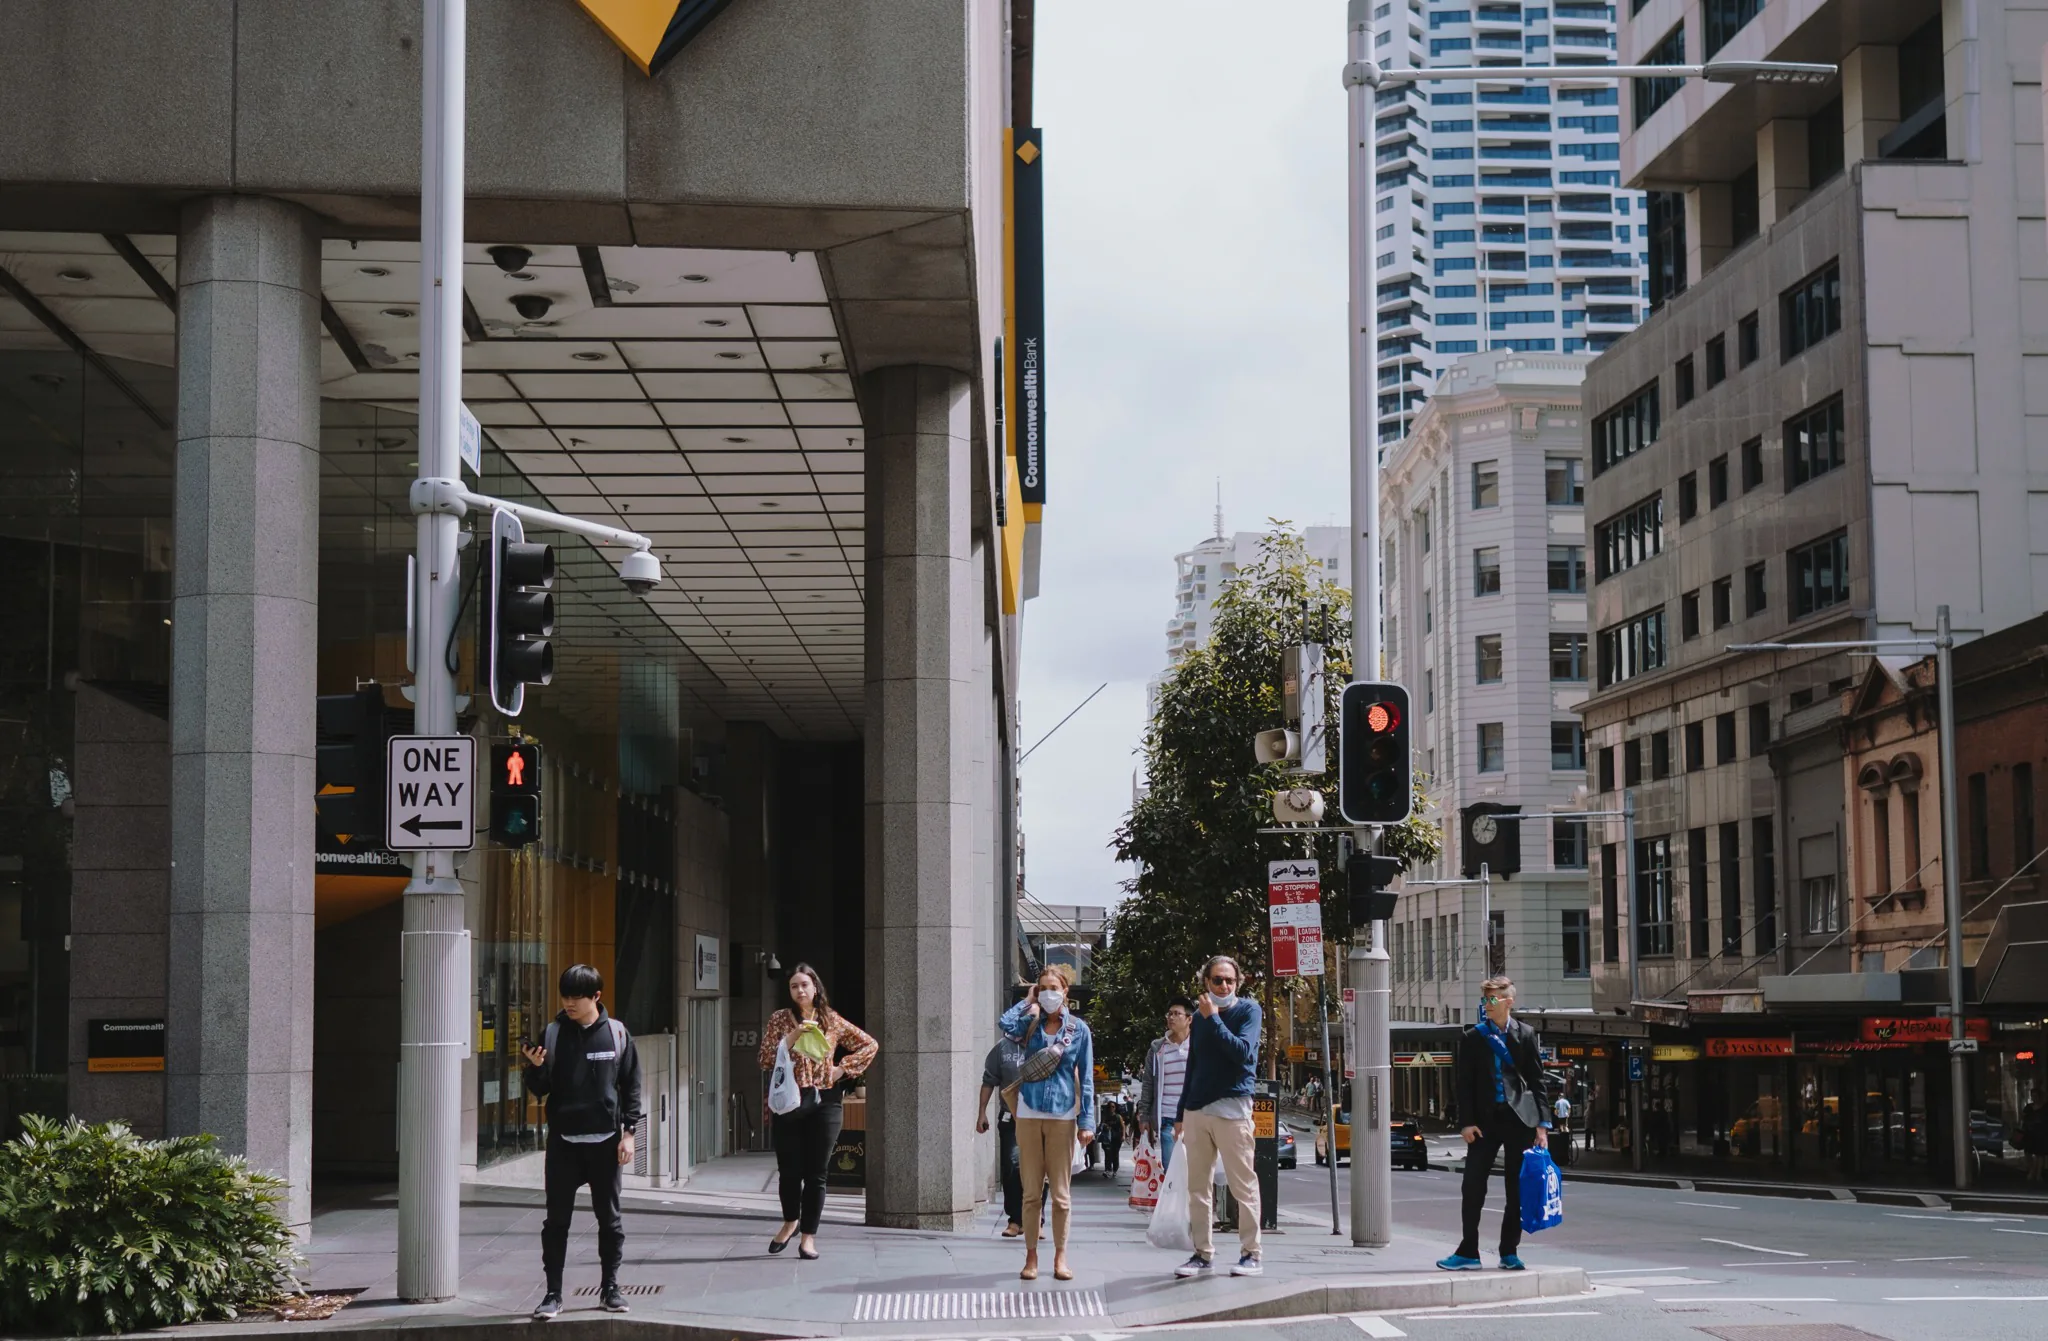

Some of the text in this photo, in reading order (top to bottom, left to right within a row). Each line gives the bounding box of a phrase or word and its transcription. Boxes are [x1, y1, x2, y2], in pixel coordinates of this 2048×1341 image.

[1024, 337, 1038, 488] CommonwealthBank
[403, 748, 460, 772] ONE
[398, 783, 464, 806] WAY
[1273, 907, 1287, 915] 4P
[732, 1031, 758, 1046] 133
[1878, 1029, 1891, 1038] MC
[1732, 1043, 1782, 1053] YASAKA
[1632, 1058, 1639, 1067] P
